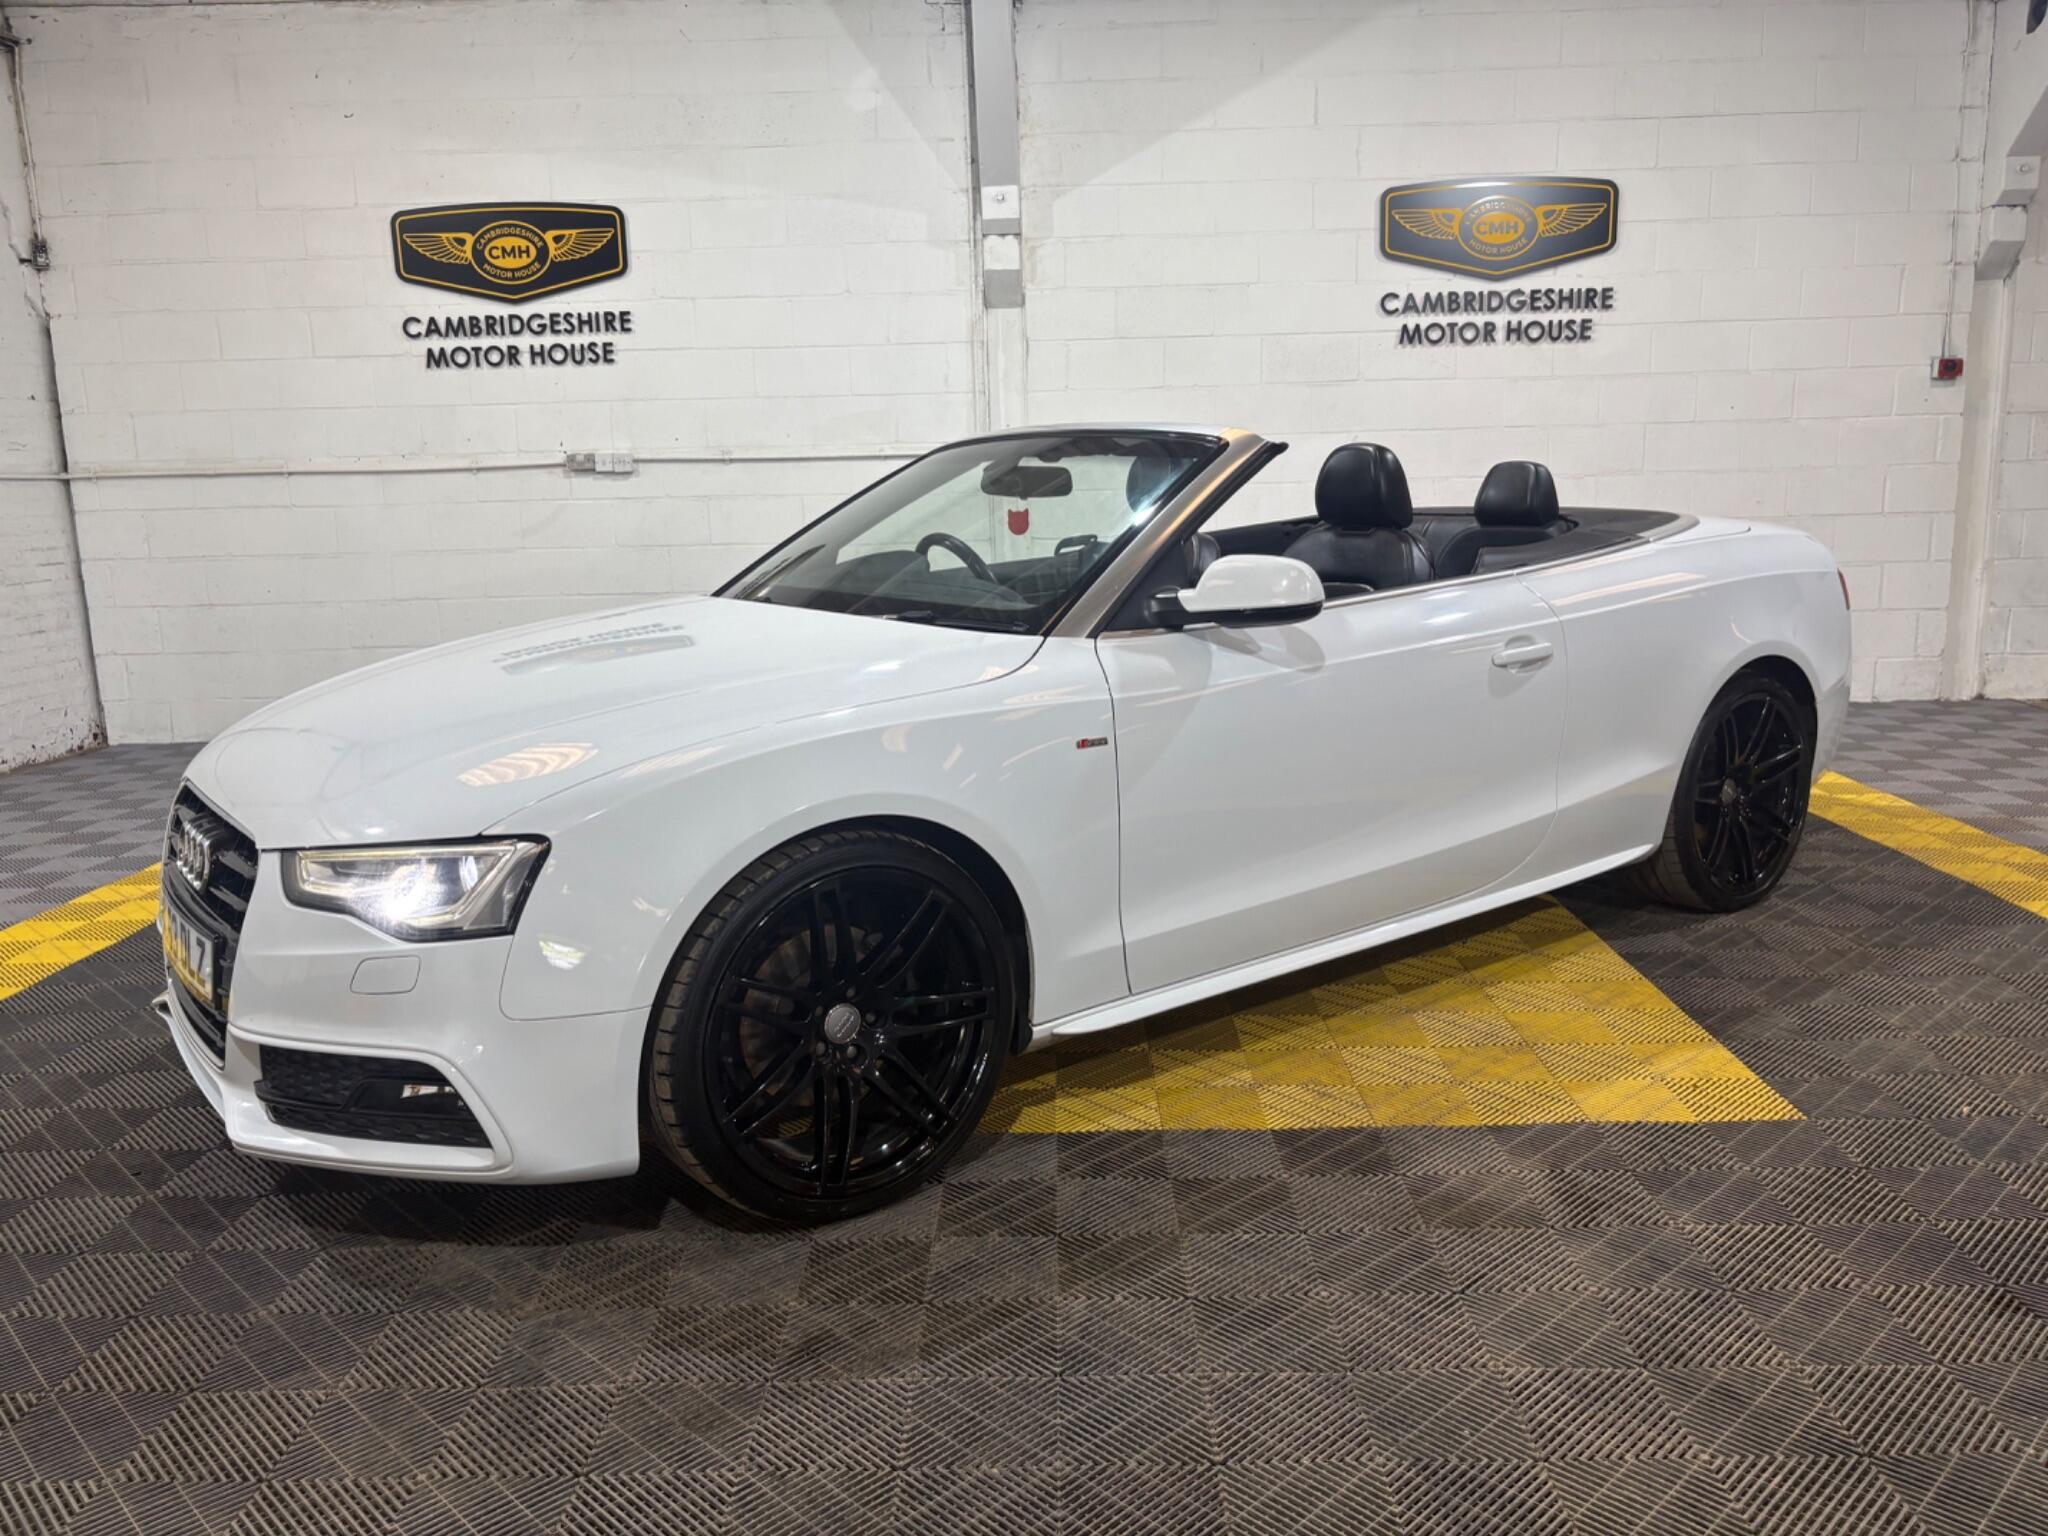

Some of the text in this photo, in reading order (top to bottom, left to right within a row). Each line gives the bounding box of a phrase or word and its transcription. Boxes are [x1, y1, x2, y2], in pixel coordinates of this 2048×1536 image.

[476, 227, 545, 250] CAMBRIDGESHIRE
[1476, 221, 1519, 236] CMH
[488, 245, 531, 260] CMH
[483, 260, 541, 279] MOTOR HOUSE
[1380, 287, 1614, 315] CAMBRIDGESHIRE
[402, 311, 632, 339] CAMBRIDGESHIRE
[1399, 318, 1593, 345] MOTOR HOUSE
[426, 342, 616, 369] MOTOR HOUSE
